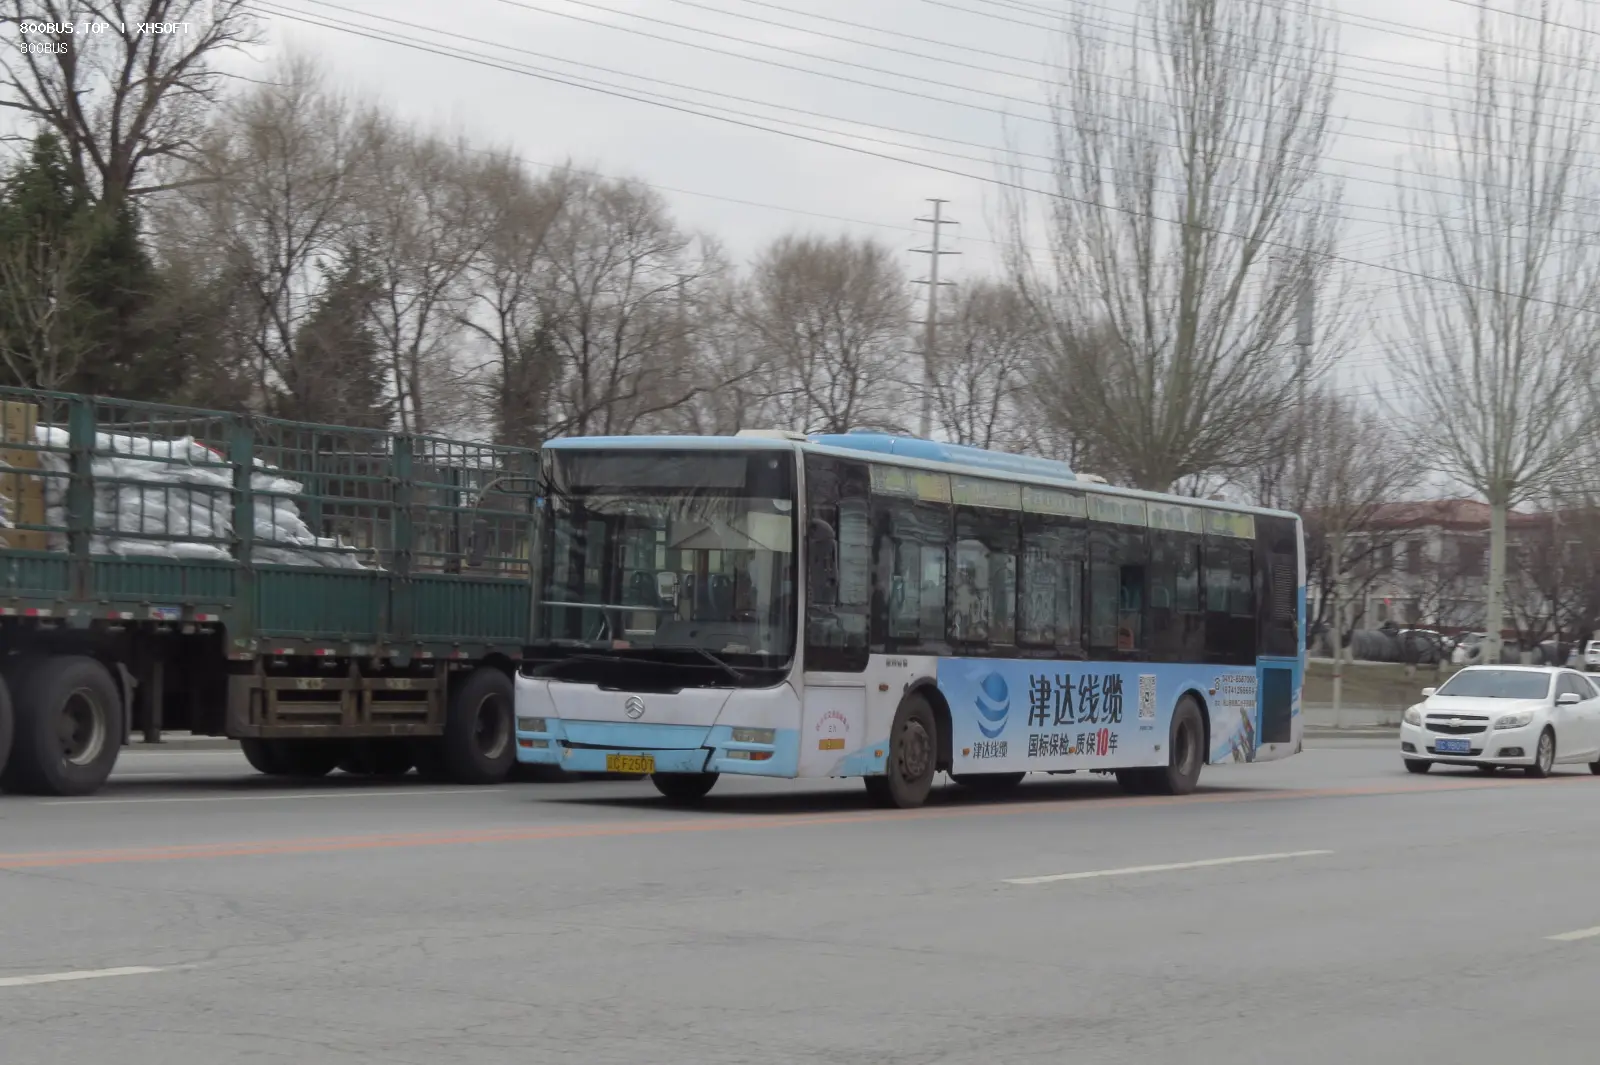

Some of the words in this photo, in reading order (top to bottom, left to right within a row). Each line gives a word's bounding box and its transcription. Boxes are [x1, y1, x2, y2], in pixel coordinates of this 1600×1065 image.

[1027, 673, 1124, 727] 津达线缆
[972, 741, 1009, 759] 津达线缆
